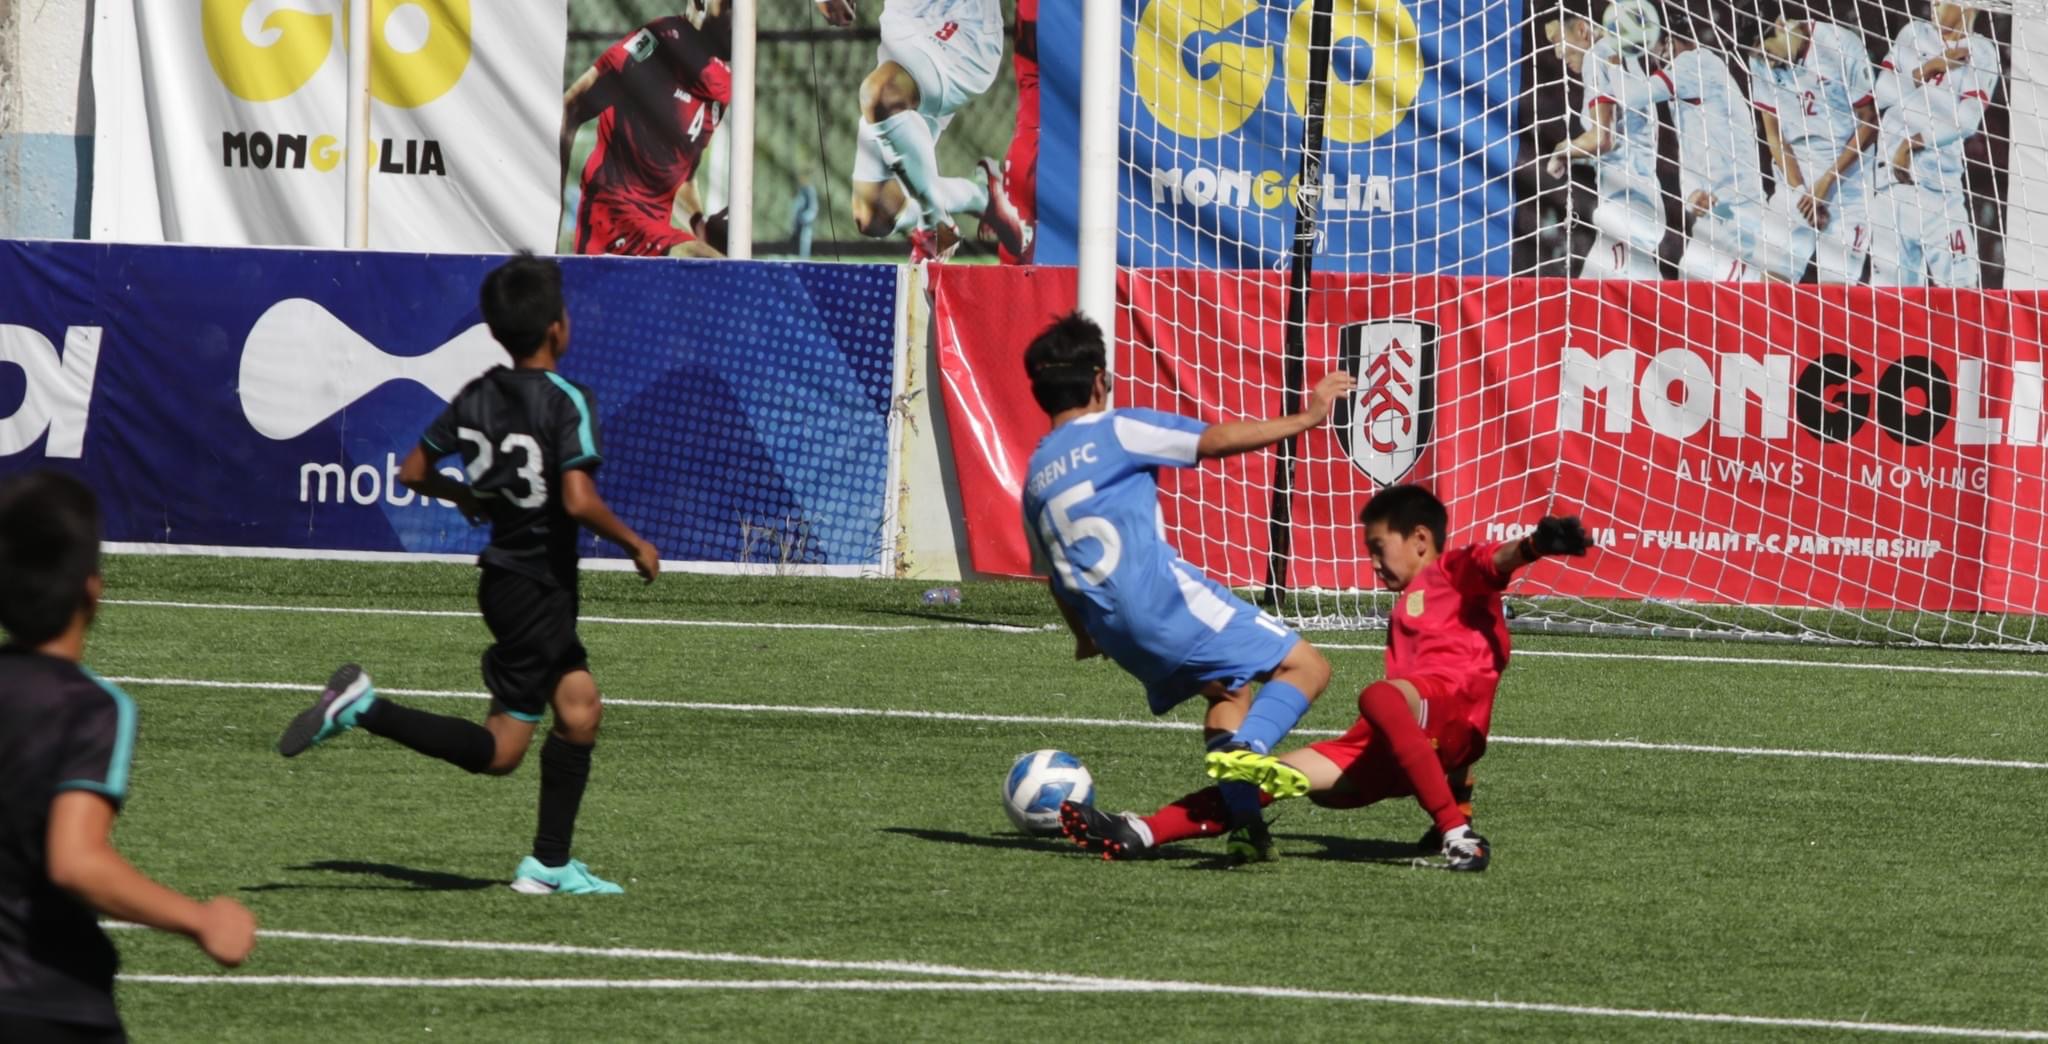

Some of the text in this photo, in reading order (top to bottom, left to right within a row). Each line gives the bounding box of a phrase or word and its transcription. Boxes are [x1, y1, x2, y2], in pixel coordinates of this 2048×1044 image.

[222, 131, 446, 176] MONGLIA
[1557, 346, 2048, 448] MONGOLI
[458, 427, 549, 509] 23
[1069, 442, 1097, 470] FC
[1676, 459, 1987, 490] ALWAYS MOVING
[1642, 531, 1741, 551] FULHAM
[1786, 534, 1942, 558] PARTNERSHIP
